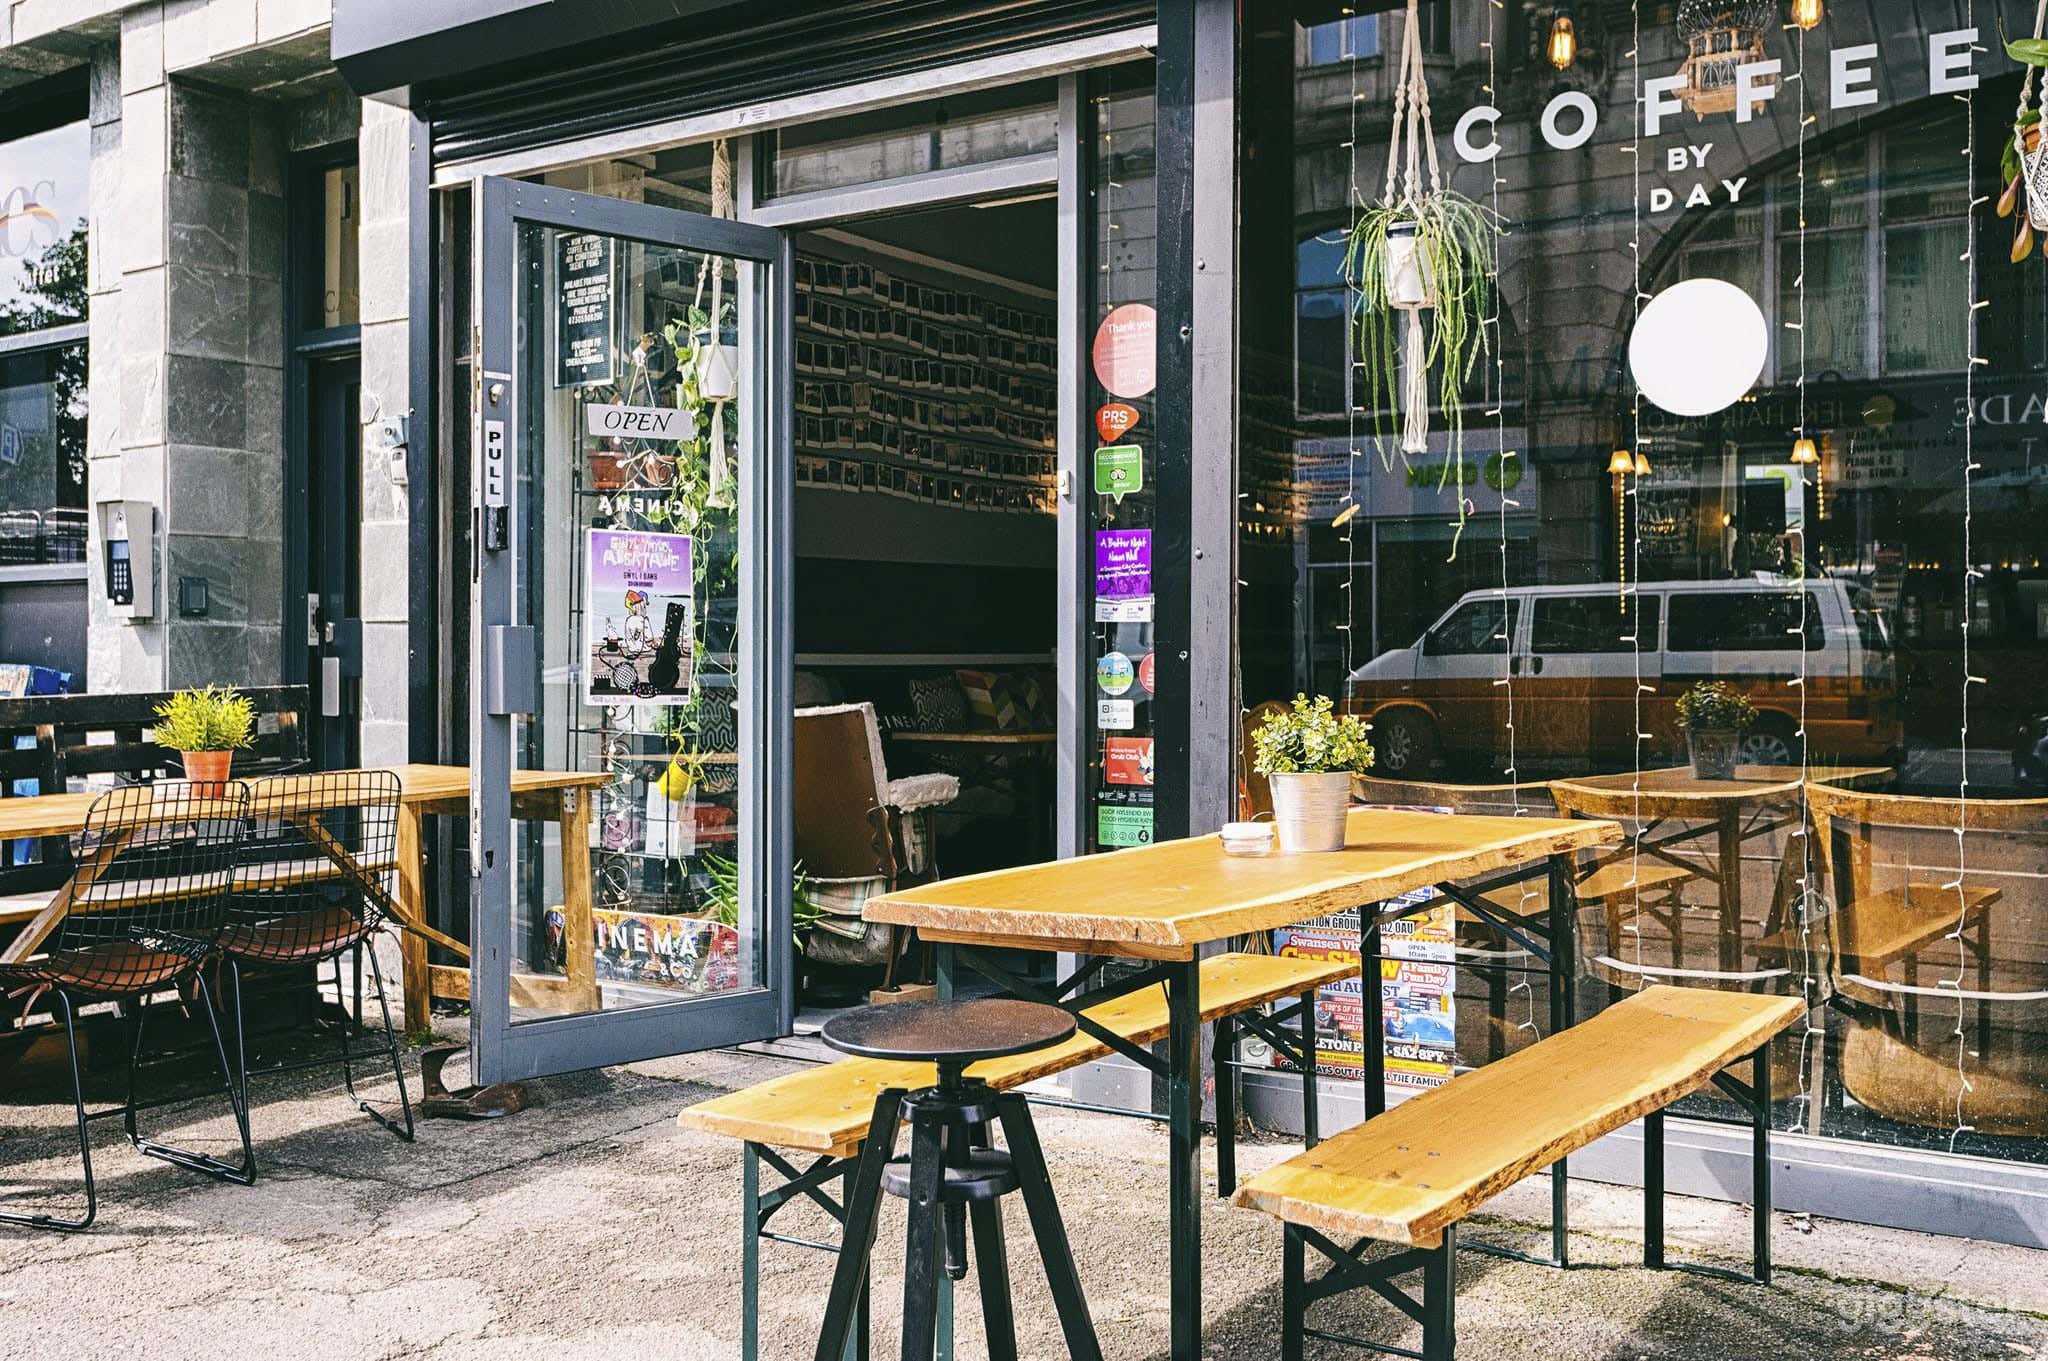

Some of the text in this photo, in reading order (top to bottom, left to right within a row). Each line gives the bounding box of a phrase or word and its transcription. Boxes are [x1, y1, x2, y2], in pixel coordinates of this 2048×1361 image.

[1453, 27, 1979, 163] COFFEE
[1667, 143, 1714, 172] BY
[1650, 177, 1749, 213] DAY
[604, 411, 673, 432] OPEN
[1102, 411, 1128, 424] PRS
[489, 431, 501, 495] PULL
[1140, 831, 1147, 841] 4
[1333, 916, 1360, 930] GROUN
[599, 925, 699, 959] INEMA
[1290, 935, 1340, 950] Swansea
[1403, 971, 1448, 987] Fun Day
[1410, 963, 1449, 977] Family
[1335, 1067, 1353, 1078] OUT
[1393, 1073, 1410, 1085] THE
